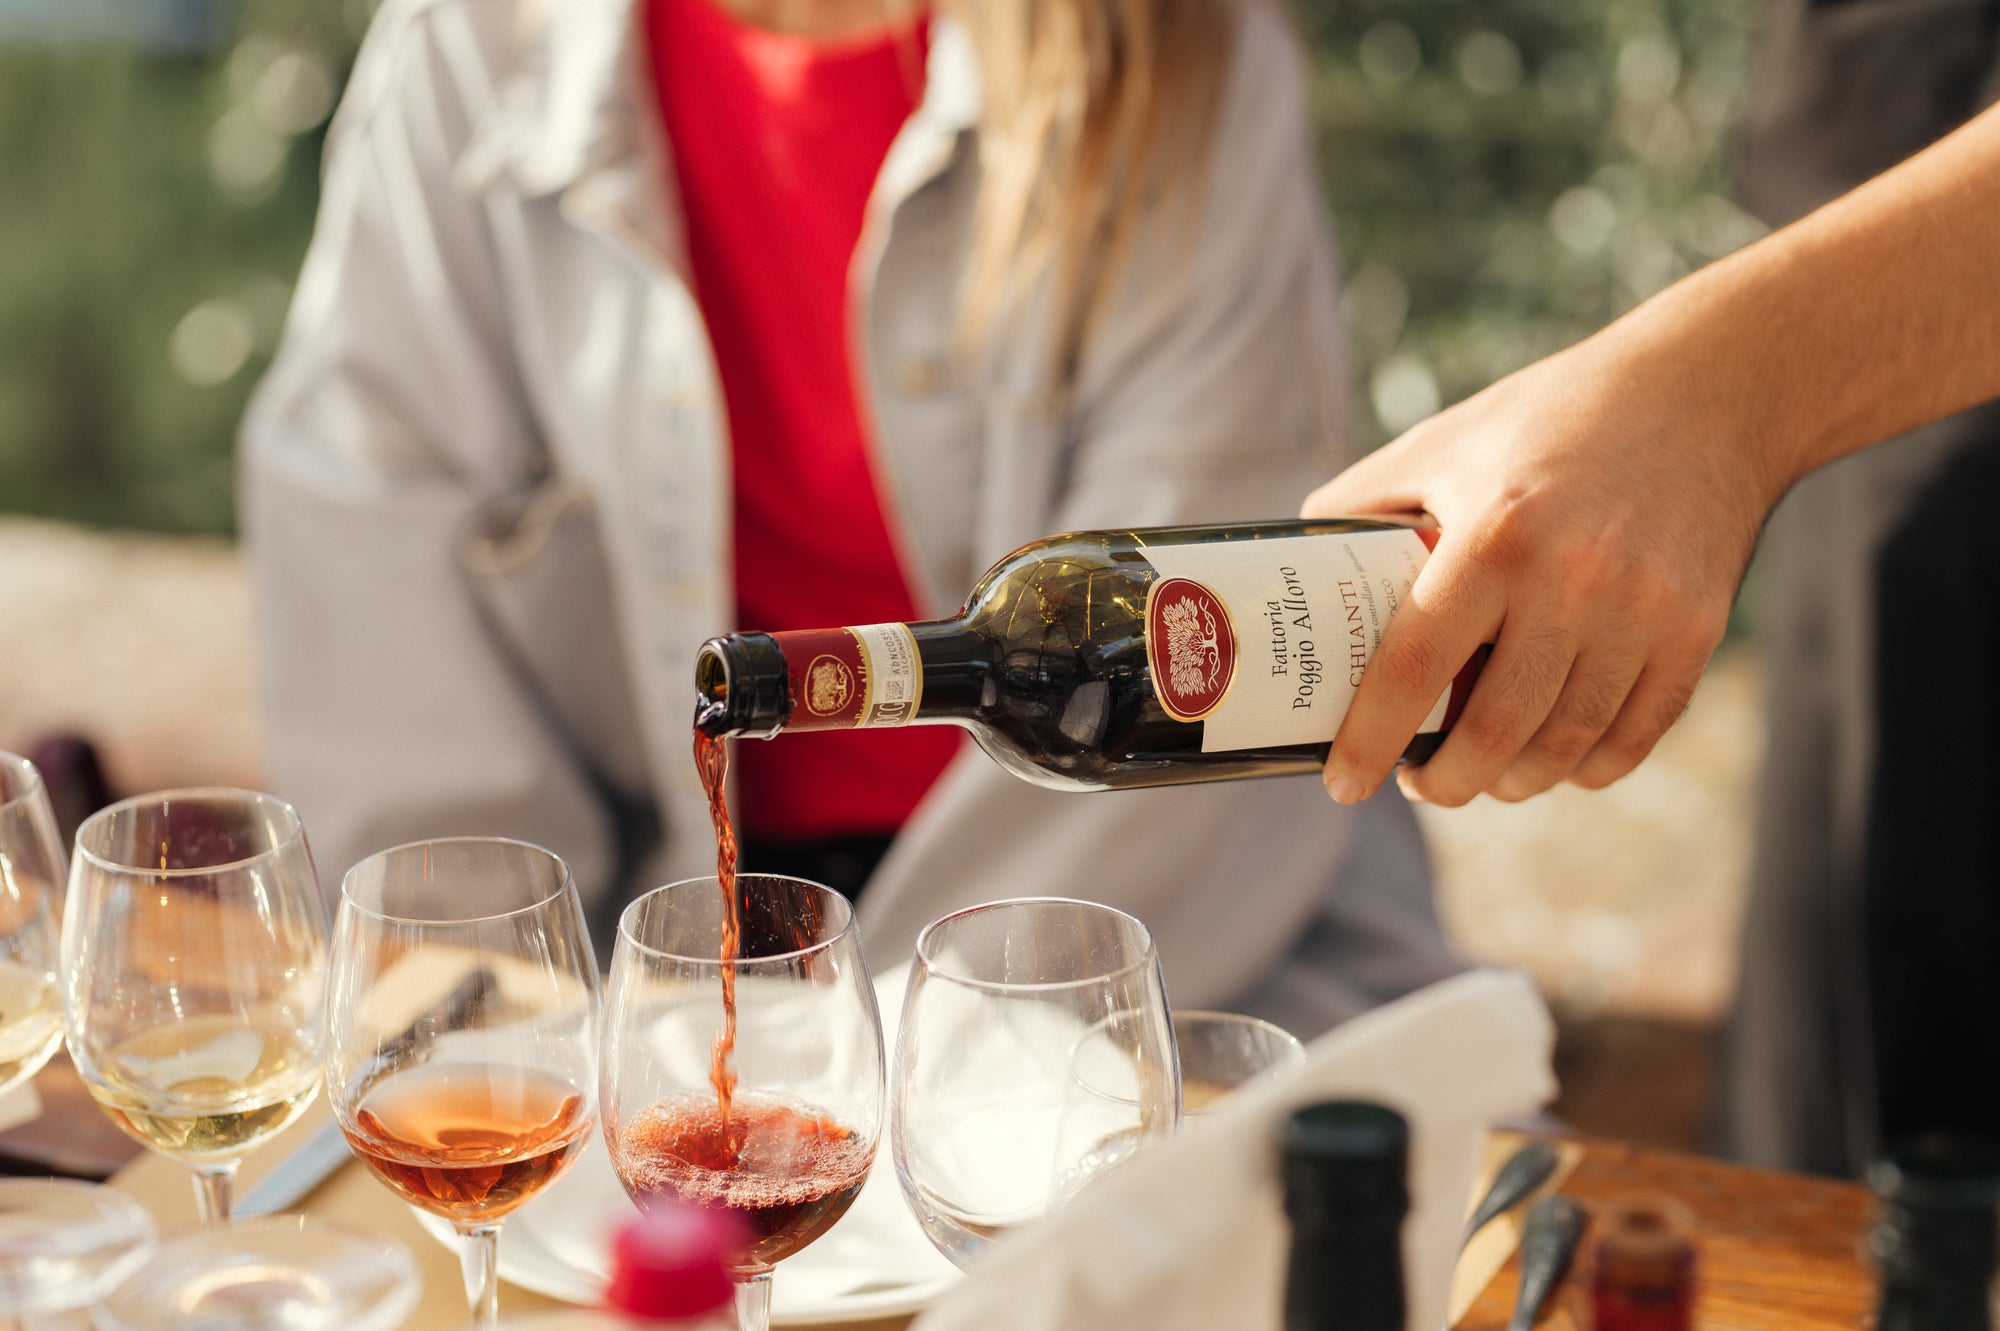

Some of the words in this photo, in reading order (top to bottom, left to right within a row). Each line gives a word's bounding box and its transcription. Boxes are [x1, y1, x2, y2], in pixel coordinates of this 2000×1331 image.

[1279, 566, 1313, 631] Alloro
[1361, 580, 1379, 626] controllata
[1382, 578, 1399, 618] OGICO
[1264, 600, 1288, 677] Fattoria
[1337, 580, 1367, 688] CHIANTI
[1292, 640, 1323, 710] Poggio
[873, 702, 906, 725] OCG
